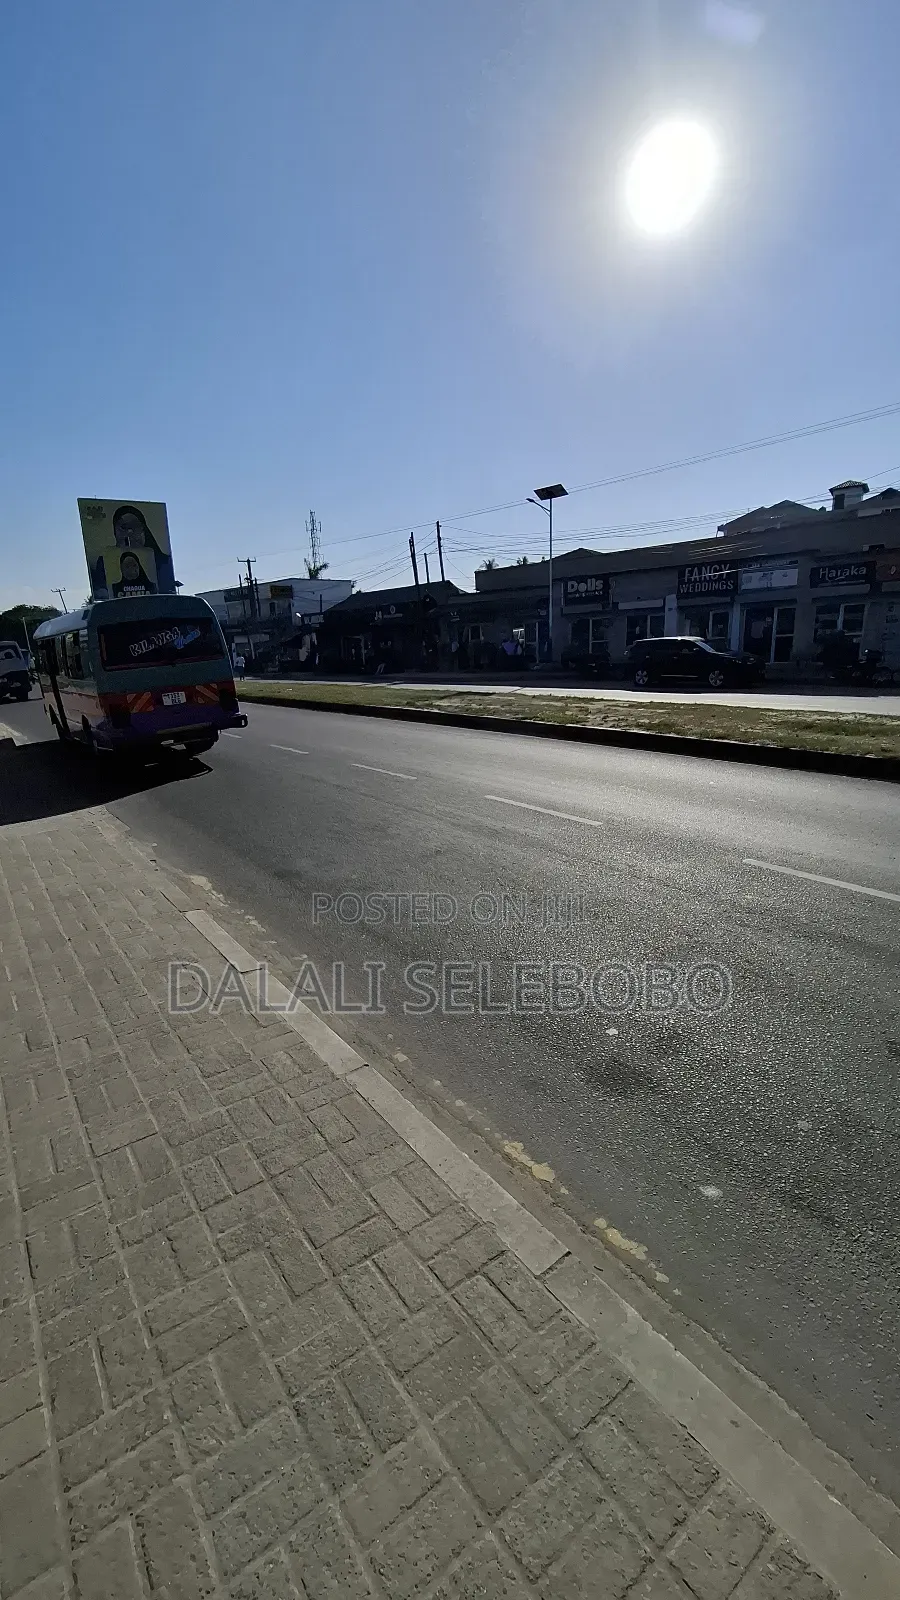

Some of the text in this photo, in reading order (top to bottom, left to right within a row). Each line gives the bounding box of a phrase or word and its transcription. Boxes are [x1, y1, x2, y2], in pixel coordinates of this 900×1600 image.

[684, 563, 730, 583] FANCY
[819, 565, 867, 581] Haraka
[567, 577, 604, 593] Dolls
[679, 580, 734, 594] WEDDINGS
